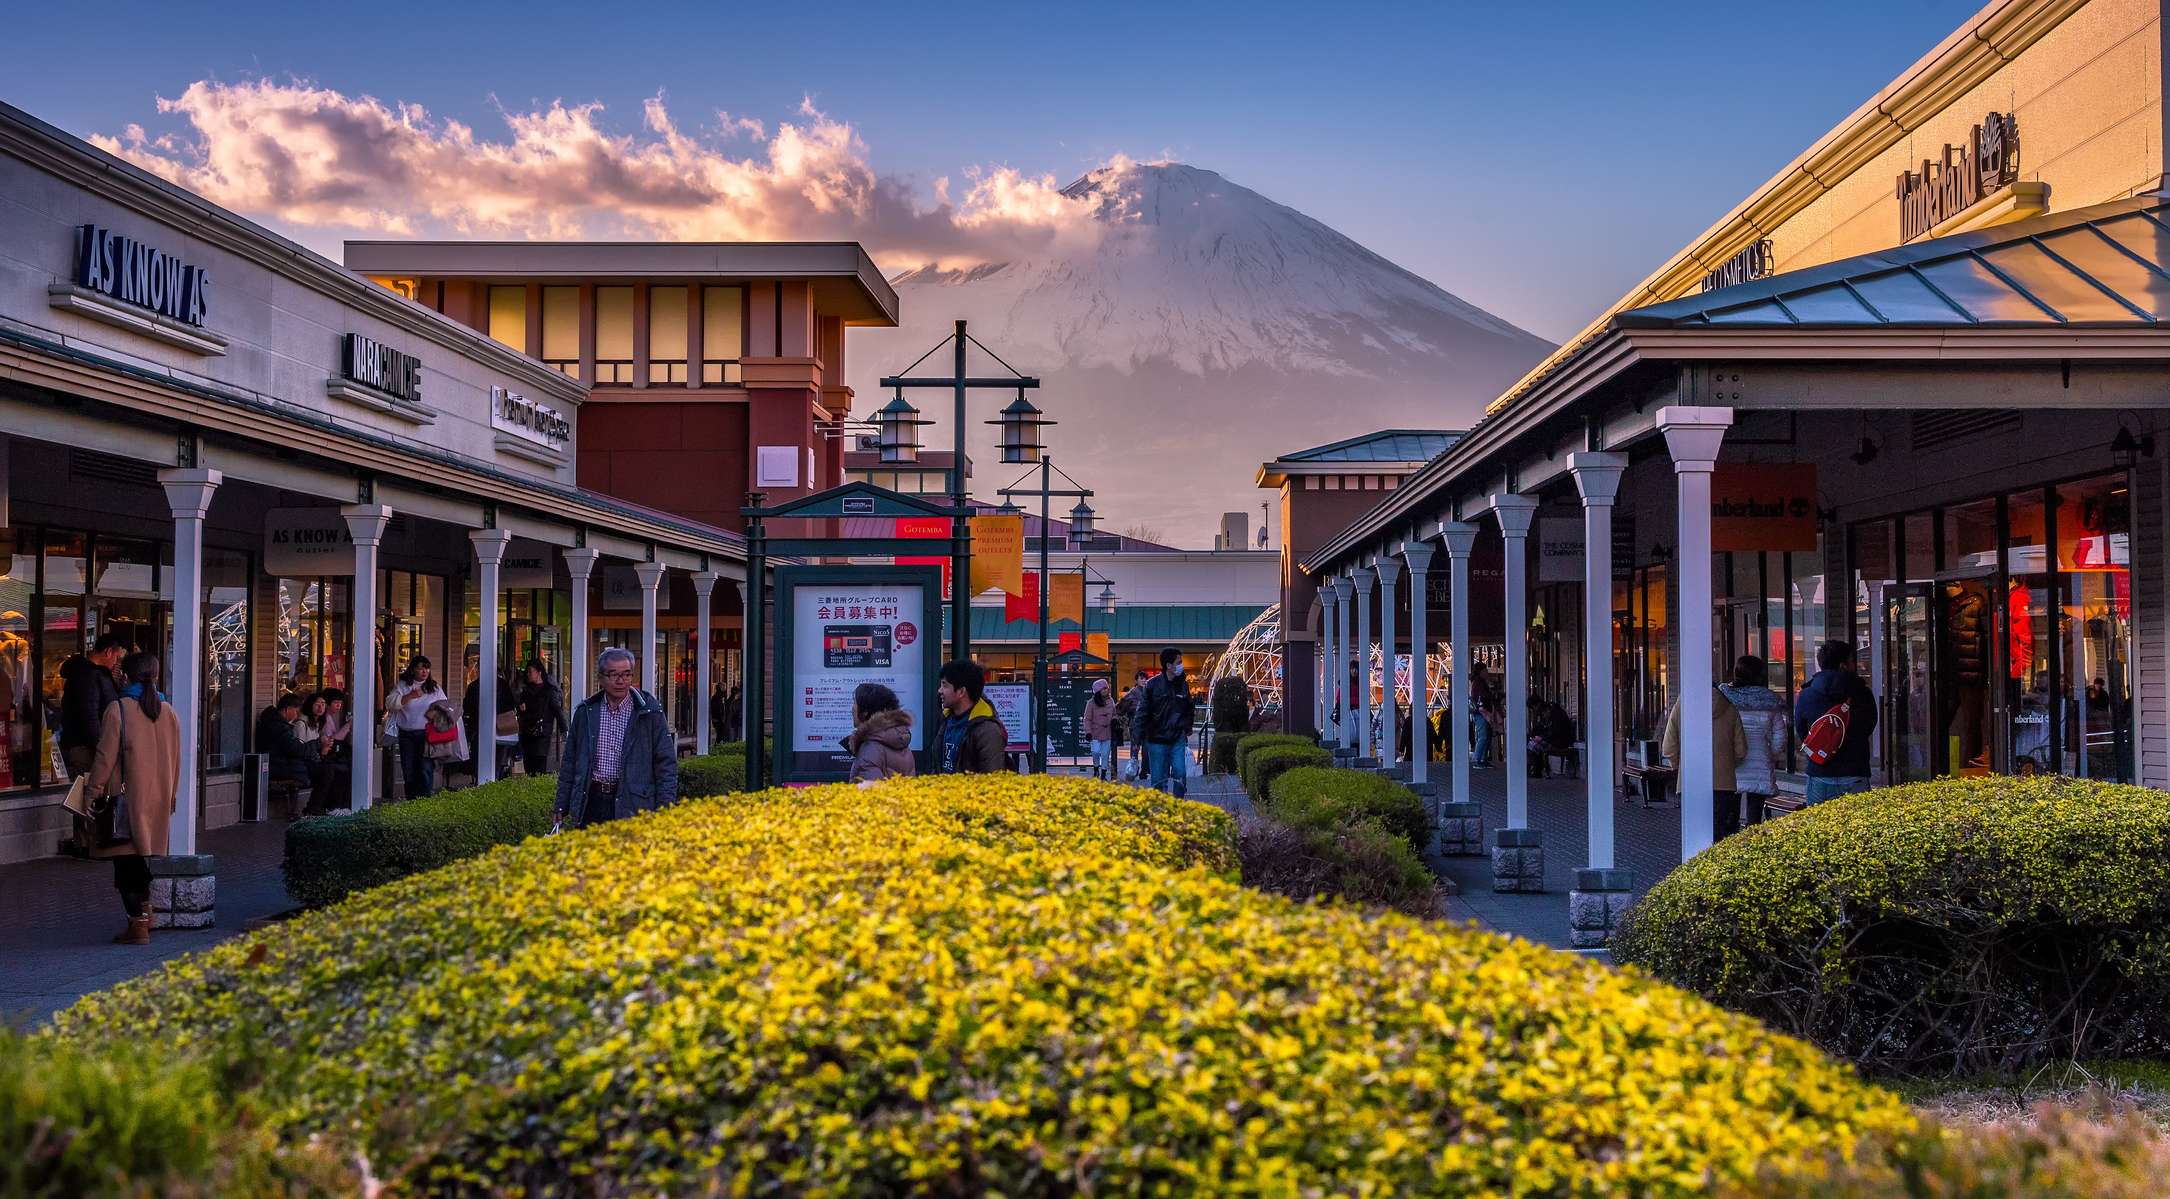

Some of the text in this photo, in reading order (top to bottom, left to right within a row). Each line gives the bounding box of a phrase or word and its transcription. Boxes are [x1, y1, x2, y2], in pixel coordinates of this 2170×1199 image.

[1896, 124, 1979, 246] Timberland
[86, 224, 209, 328] AS KNOW AS
[272, 528, 354, 544] AS KNOW A
[903, 525, 943, 534] GOTEMBA
[818, 606, 898, 620] 会員募集中!
